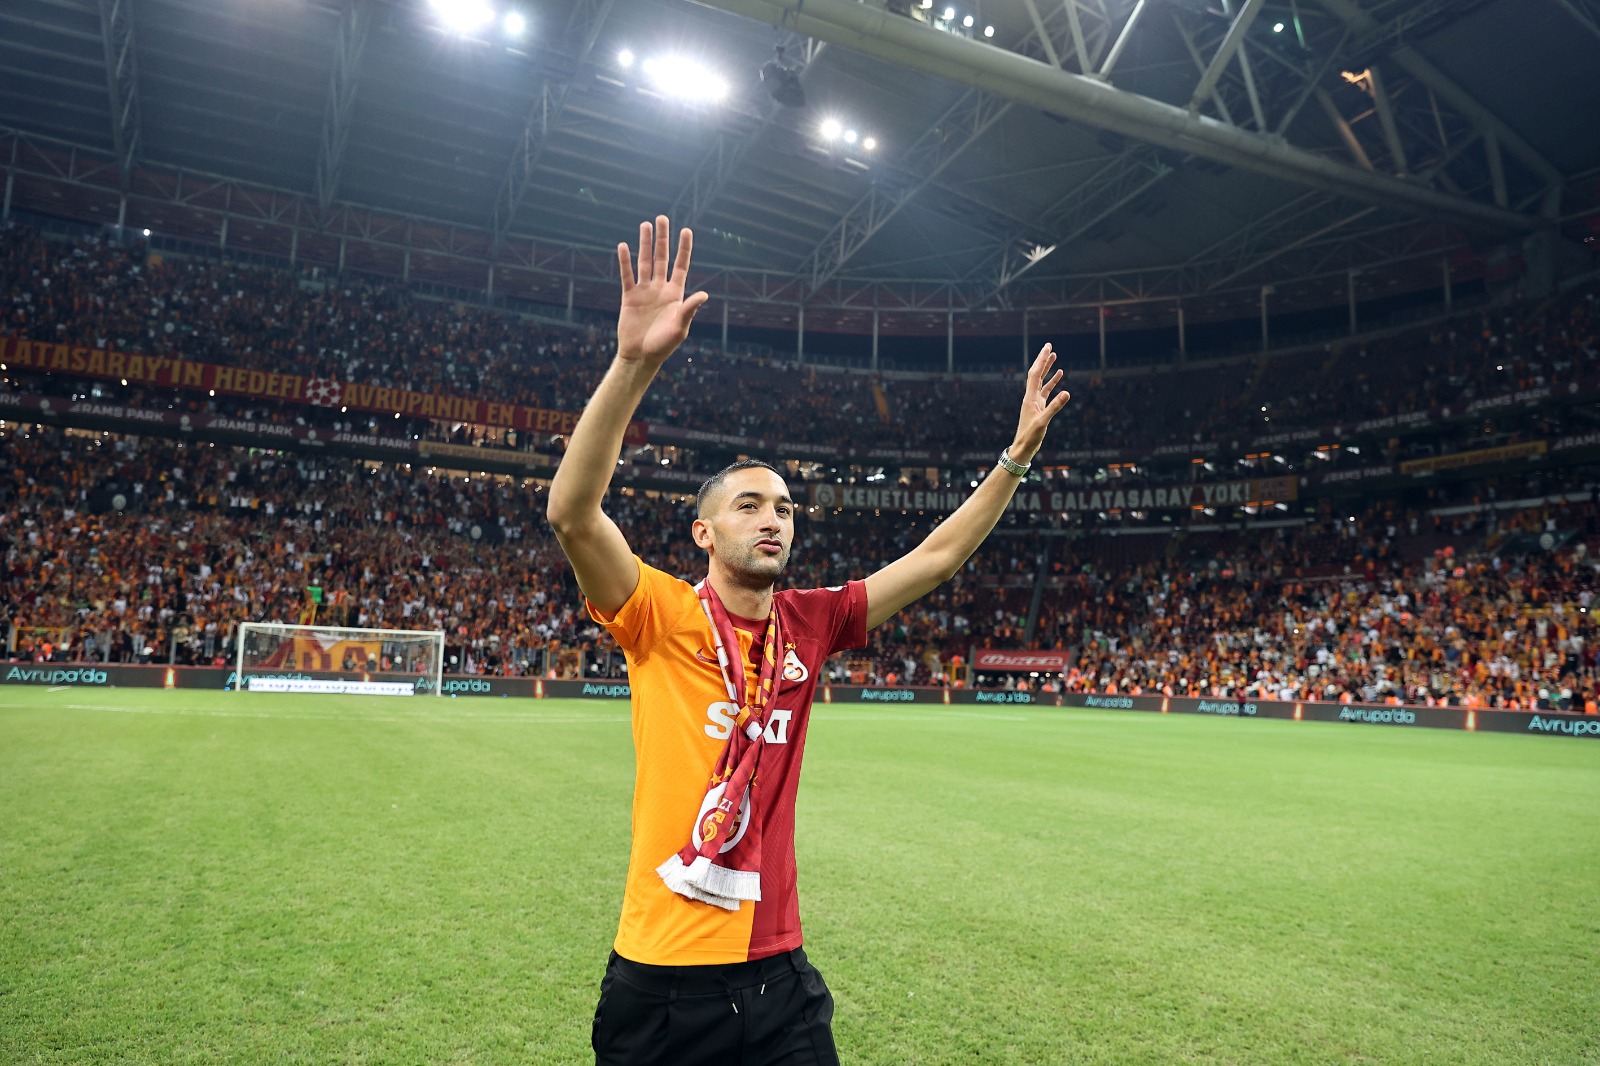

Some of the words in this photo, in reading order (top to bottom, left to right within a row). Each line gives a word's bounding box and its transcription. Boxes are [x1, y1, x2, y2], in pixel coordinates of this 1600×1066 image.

[80, 402, 123, 418] RAMS
[126, 408, 165, 423] PARK
[486, 401, 515, 426] EN
[218, 420, 256, 434] RAMS
[259, 423, 293, 437] PARK
[342, 432, 377, 447] RAMS
[379, 437, 411, 450] PARK
[1564, 433, 1600, 448] RAM
[1051, 486, 1194, 511] GALATASARAY
[1203, 482, 1252, 504] YOK!
[6, 665, 107, 684] Avrupa'da
[416, 676, 491, 693] Avupa'da
[1339, 705, 1416, 724] Avrupa'da
